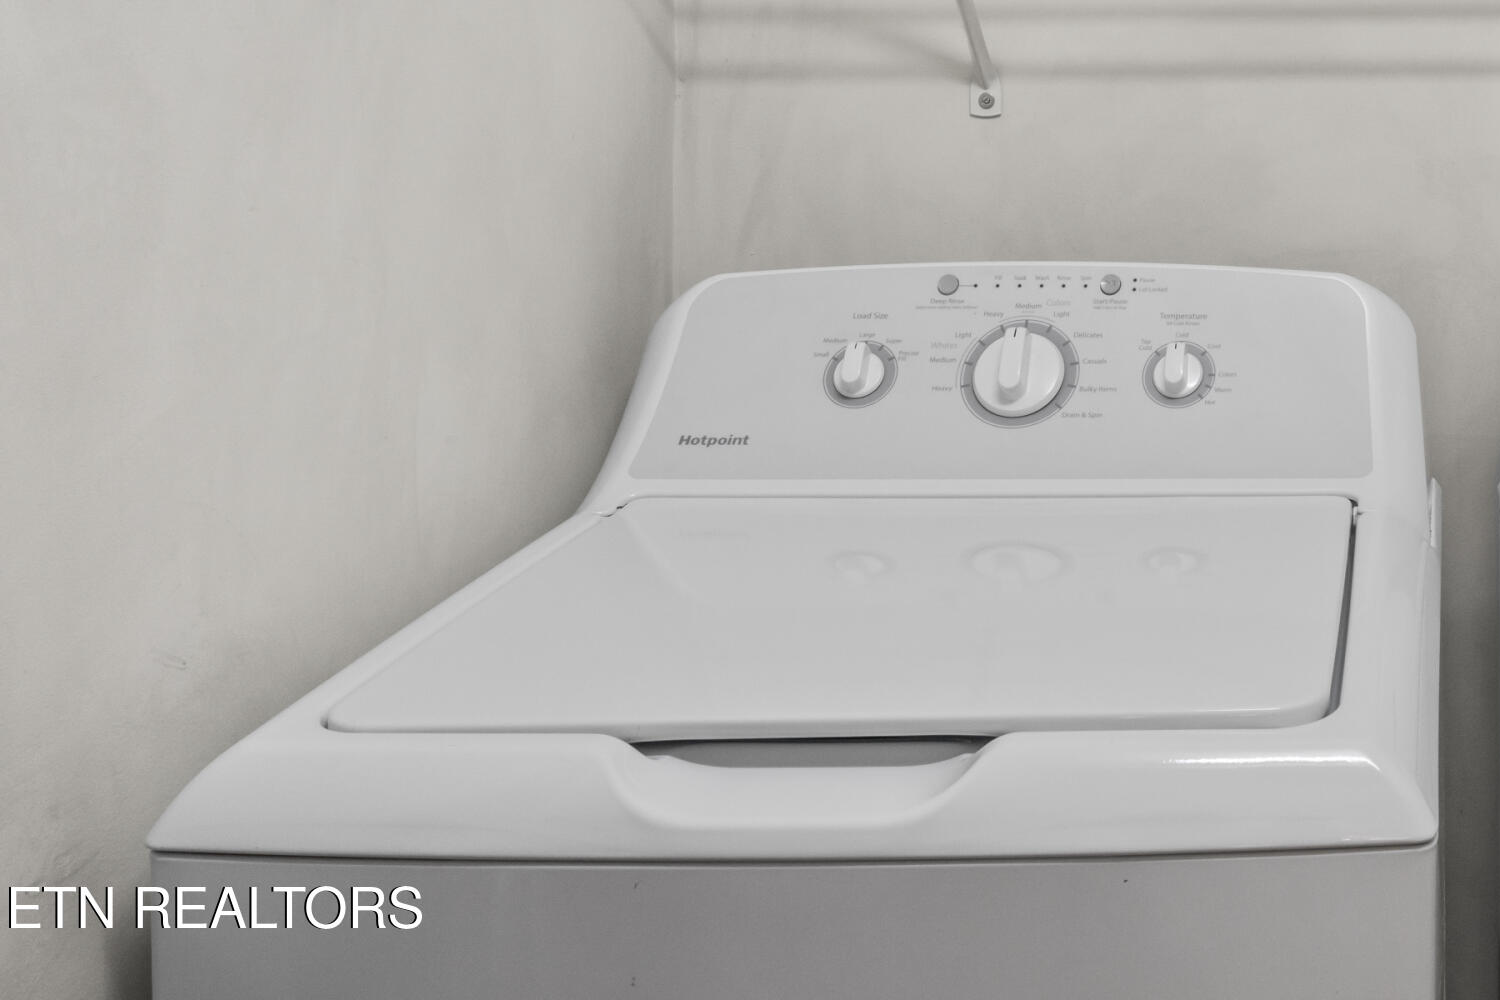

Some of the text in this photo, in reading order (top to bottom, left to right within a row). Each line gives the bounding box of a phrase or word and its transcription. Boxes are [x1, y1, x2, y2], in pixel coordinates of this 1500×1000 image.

[852, 311, 889, 320] Load Size
[1053, 310, 1070, 318] Light
[1160, 312, 1208, 321] Temperature
[954, 331, 972, 339] Light
[678, 434, 750, 448] Hotpoint
